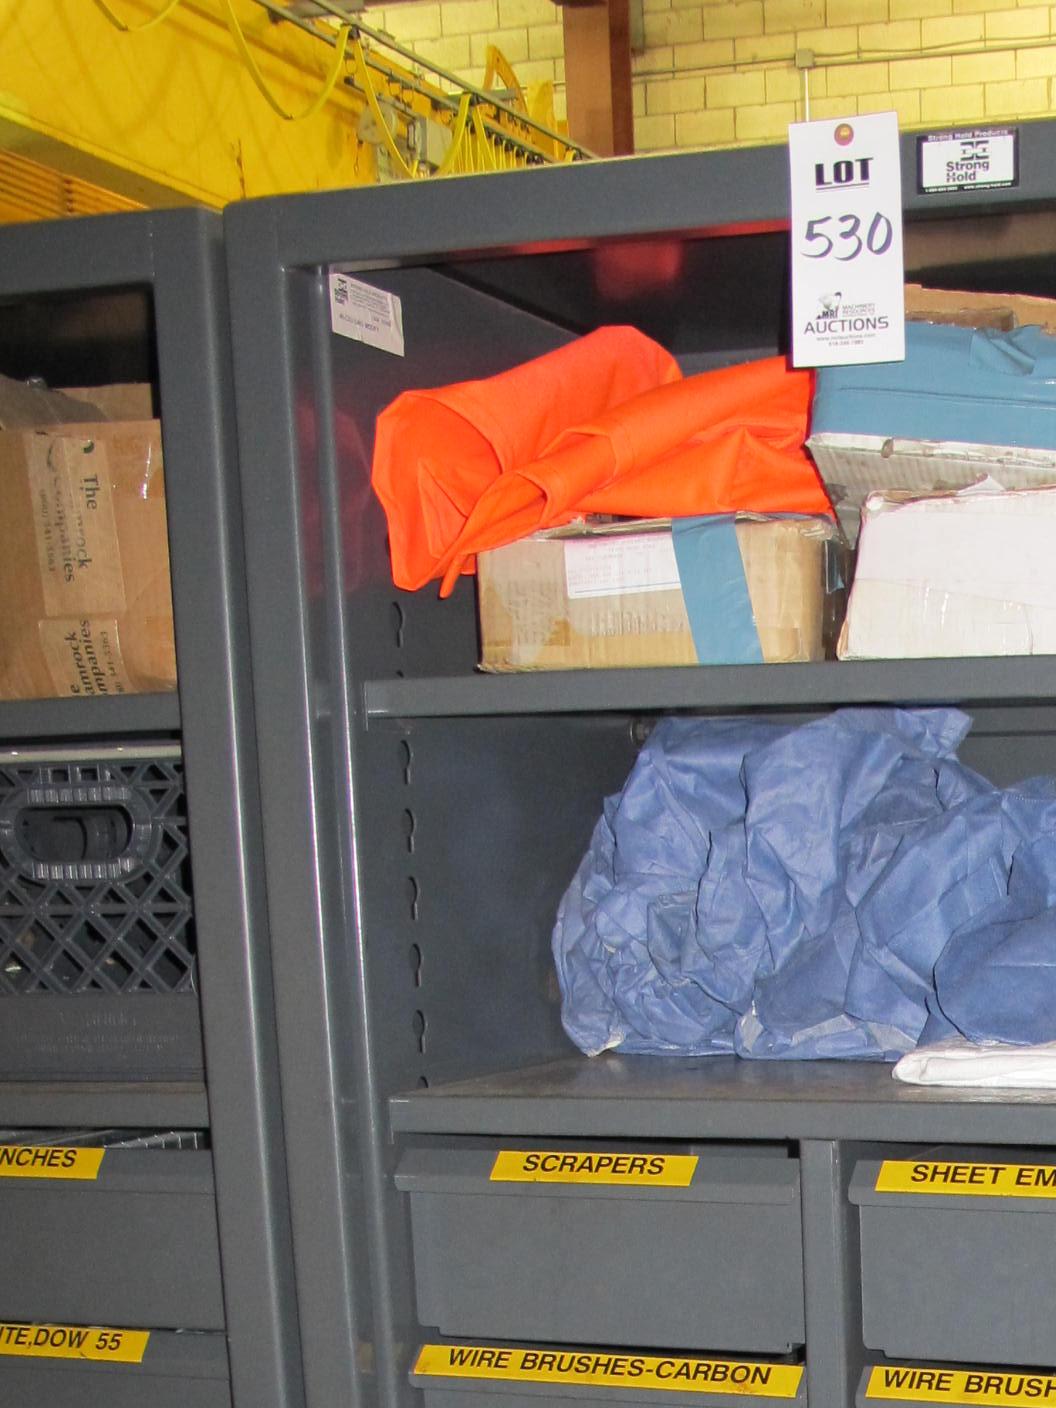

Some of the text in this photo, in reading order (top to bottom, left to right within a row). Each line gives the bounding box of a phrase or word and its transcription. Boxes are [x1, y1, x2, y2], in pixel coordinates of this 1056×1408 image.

[815, 157, 874, 187] LOT
[946, 160, 990, 172] Strong
[946, 171, 977, 183] Hold
[800, 211, 893, 262] 530
[803, 316, 889, 335] AUCTIONS
[84, 474, 101, 511] The
[523, 1154, 665, 1176] SCRAPERS
[911, 1164, 1006, 1184] SHEET
[95, 1332, 123, 1351] 55
[450, 1349, 772, 1384] WIRE BRUSHES-CARBON
[885, 1370, 955, 1391] WIRE
